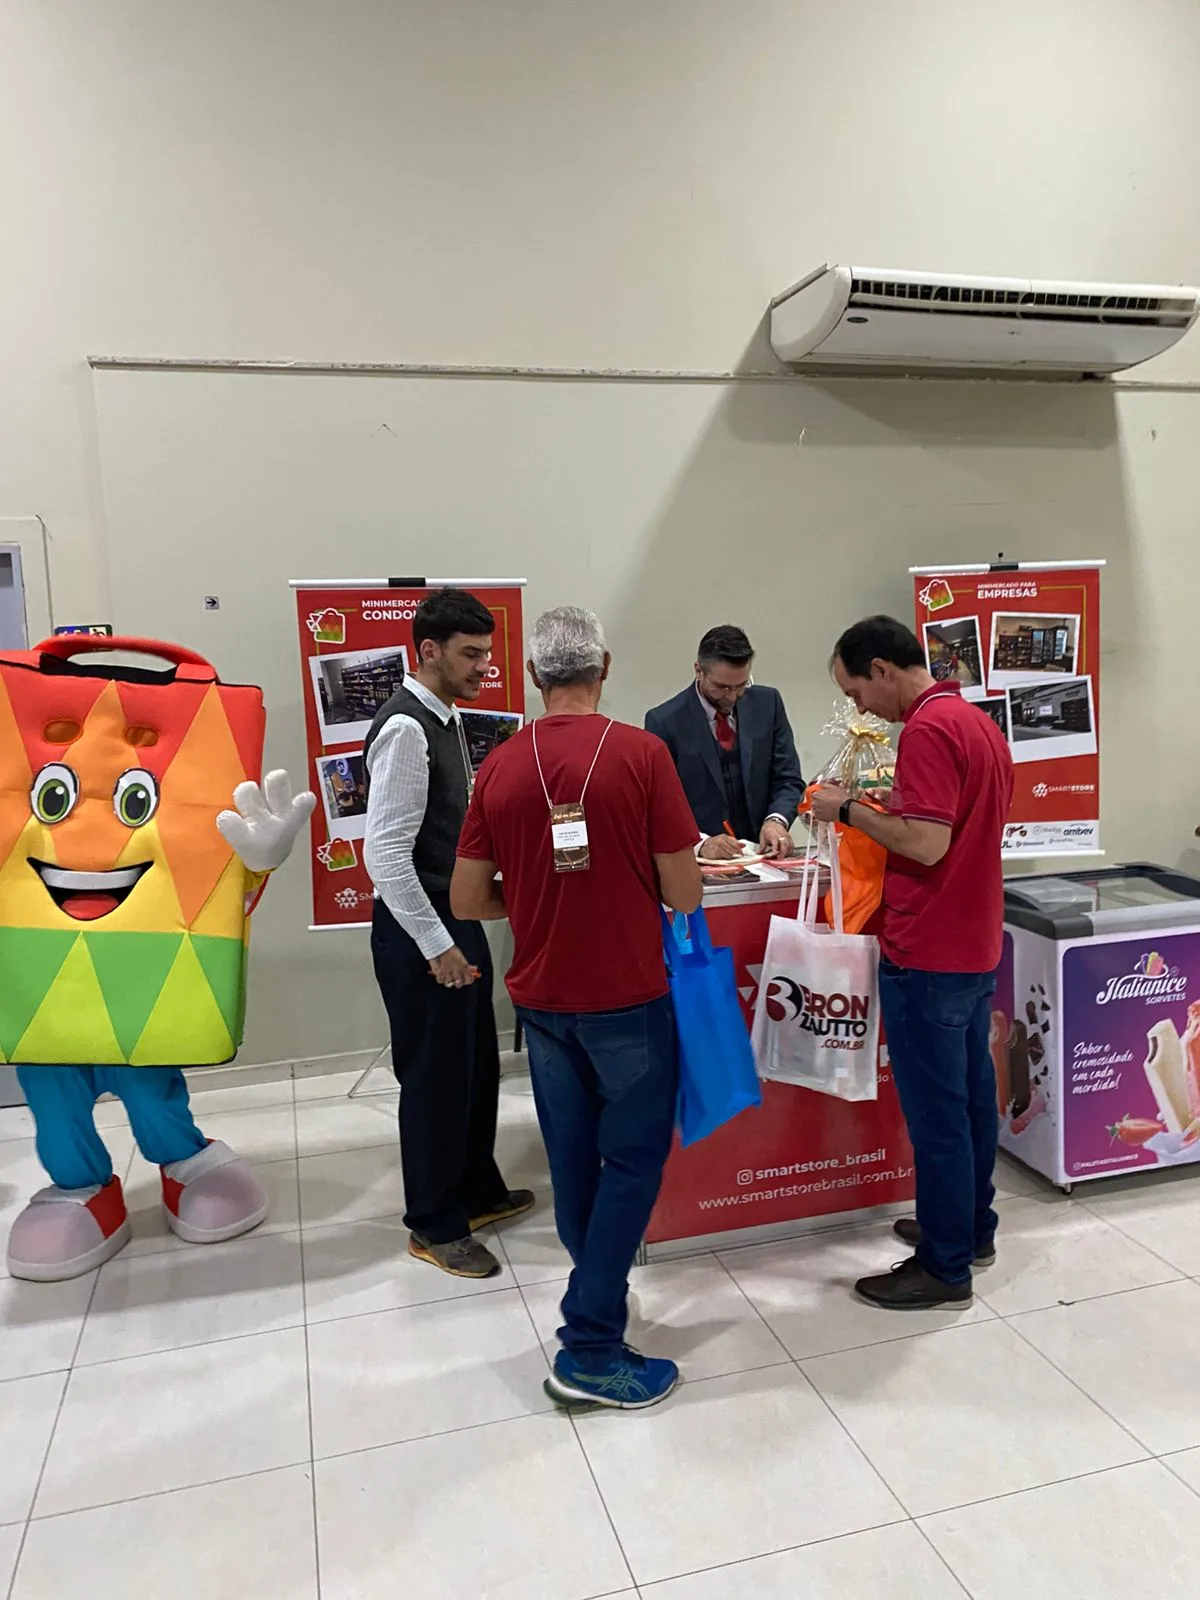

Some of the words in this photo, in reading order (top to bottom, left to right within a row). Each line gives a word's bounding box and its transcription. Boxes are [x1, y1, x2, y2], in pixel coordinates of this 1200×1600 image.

[977, 588, 1038, 599] EMPRESAS
[1145, 993, 1186, 1005] SORVETES
[1073, 1041, 1103, 1058] Sabor
[1072, 1049, 1134, 1069] cremosidade
[1089, 1065, 1114, 1080] cada
[1072, 1072, 1122, 1094] mordida!
[755, 1149, 886, 1180] smartstore_brasil
[698, 1166, 914, 1210] www.smartstorebrasil.com.br
